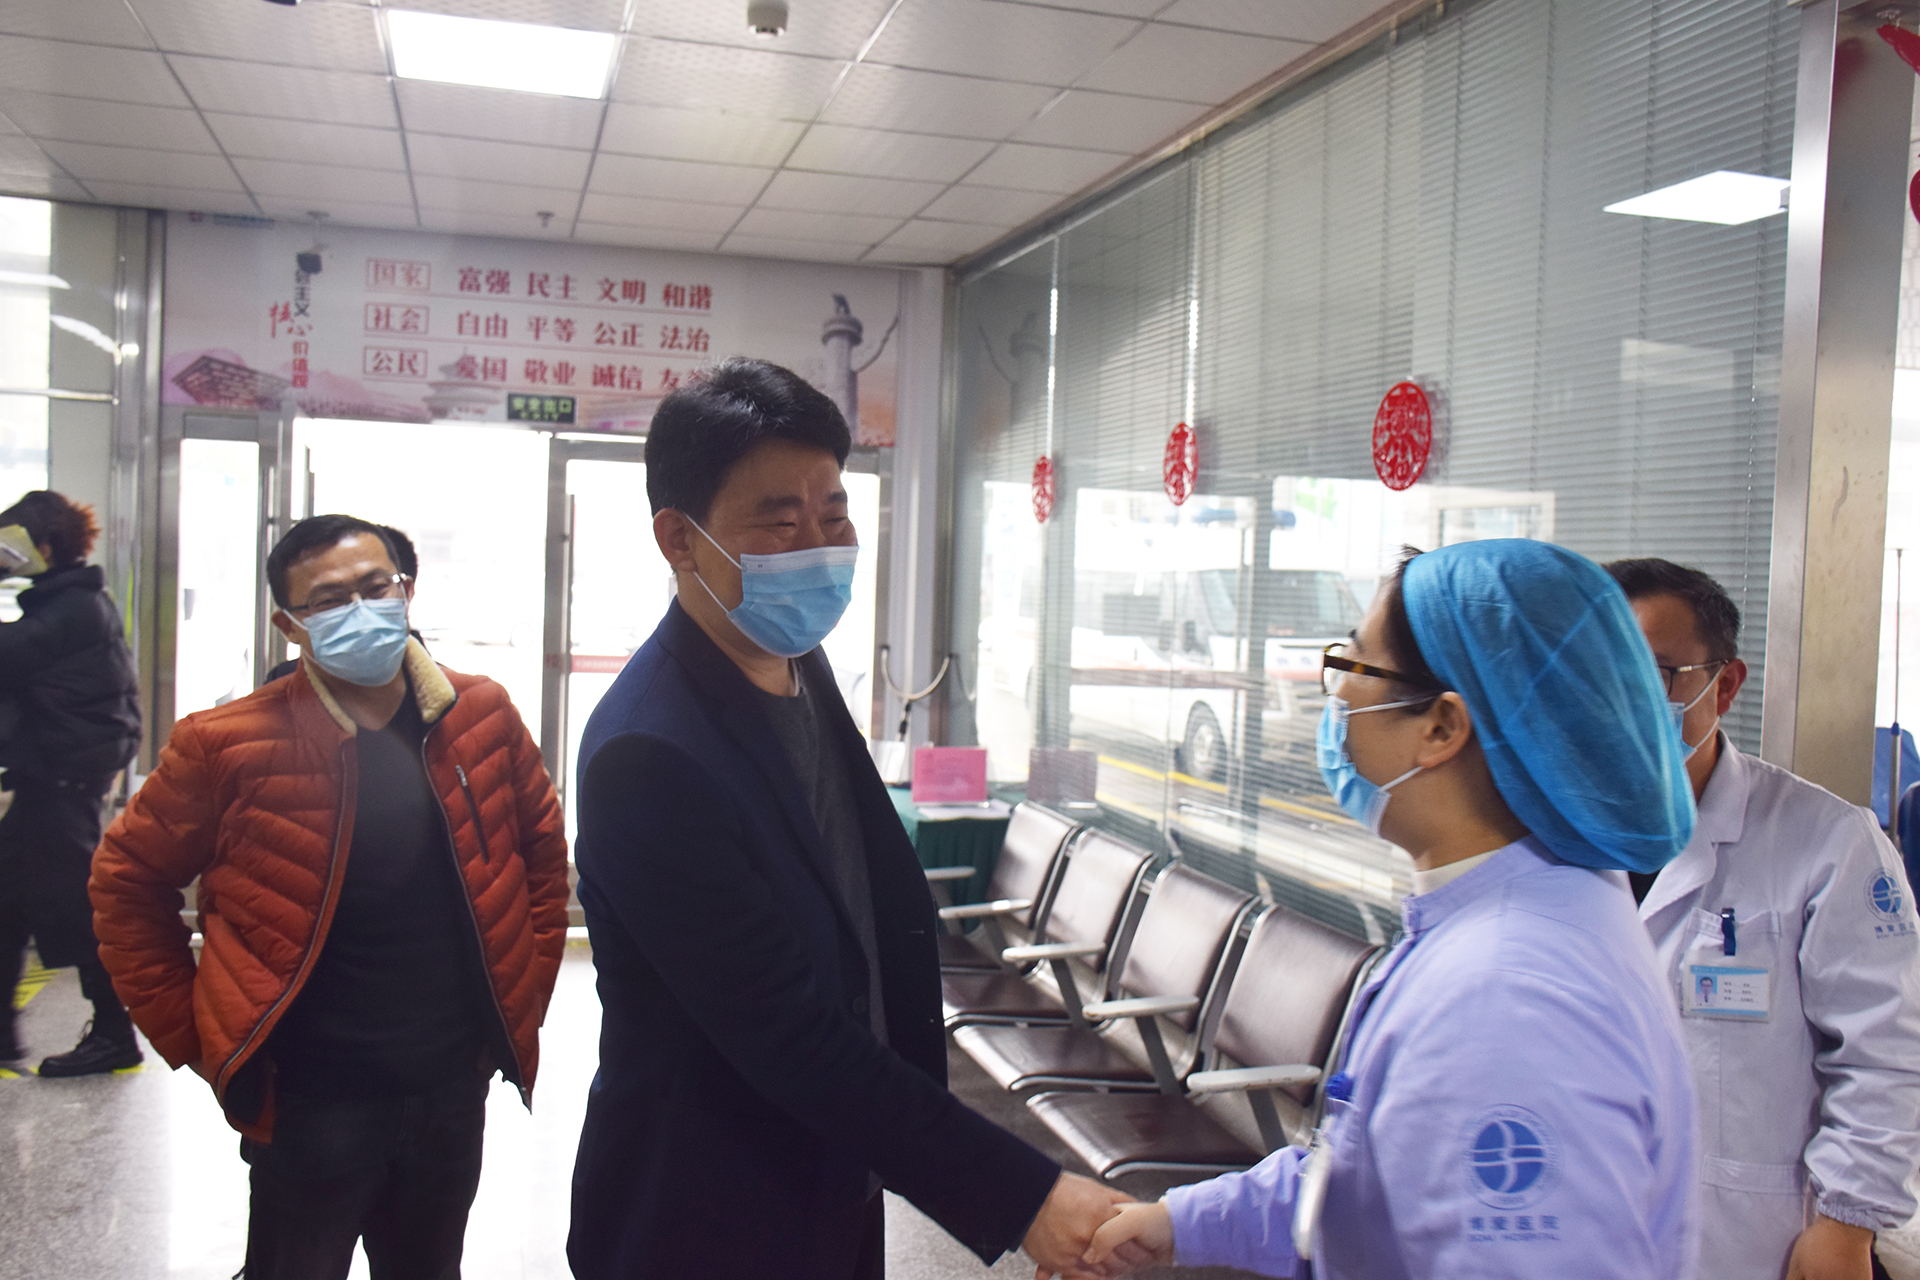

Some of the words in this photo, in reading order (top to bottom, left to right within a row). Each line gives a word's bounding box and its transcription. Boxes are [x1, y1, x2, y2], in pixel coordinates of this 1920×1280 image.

[373, 262, 422, 286] 国家
[457, 267, 511, 294] 富强
[527, 272, 577, 299] 民主
[598, 277, 646, 304] 文明
[662, 283, 712, 310] 和谐
[373, 307, 421, 331] 社会
[457, 311, 508, 339] 自由
[527, 316, 576, 342] 平等
[595, 322, 644, 348] 公正
[660, 325, 711, 352] 法治
[372, 350, 418, 375] 公民
[456, 355, 507, 382] 爱国
[525, 359, 576, 385] 敬业
[592, 364, 643, 391] 诚信
